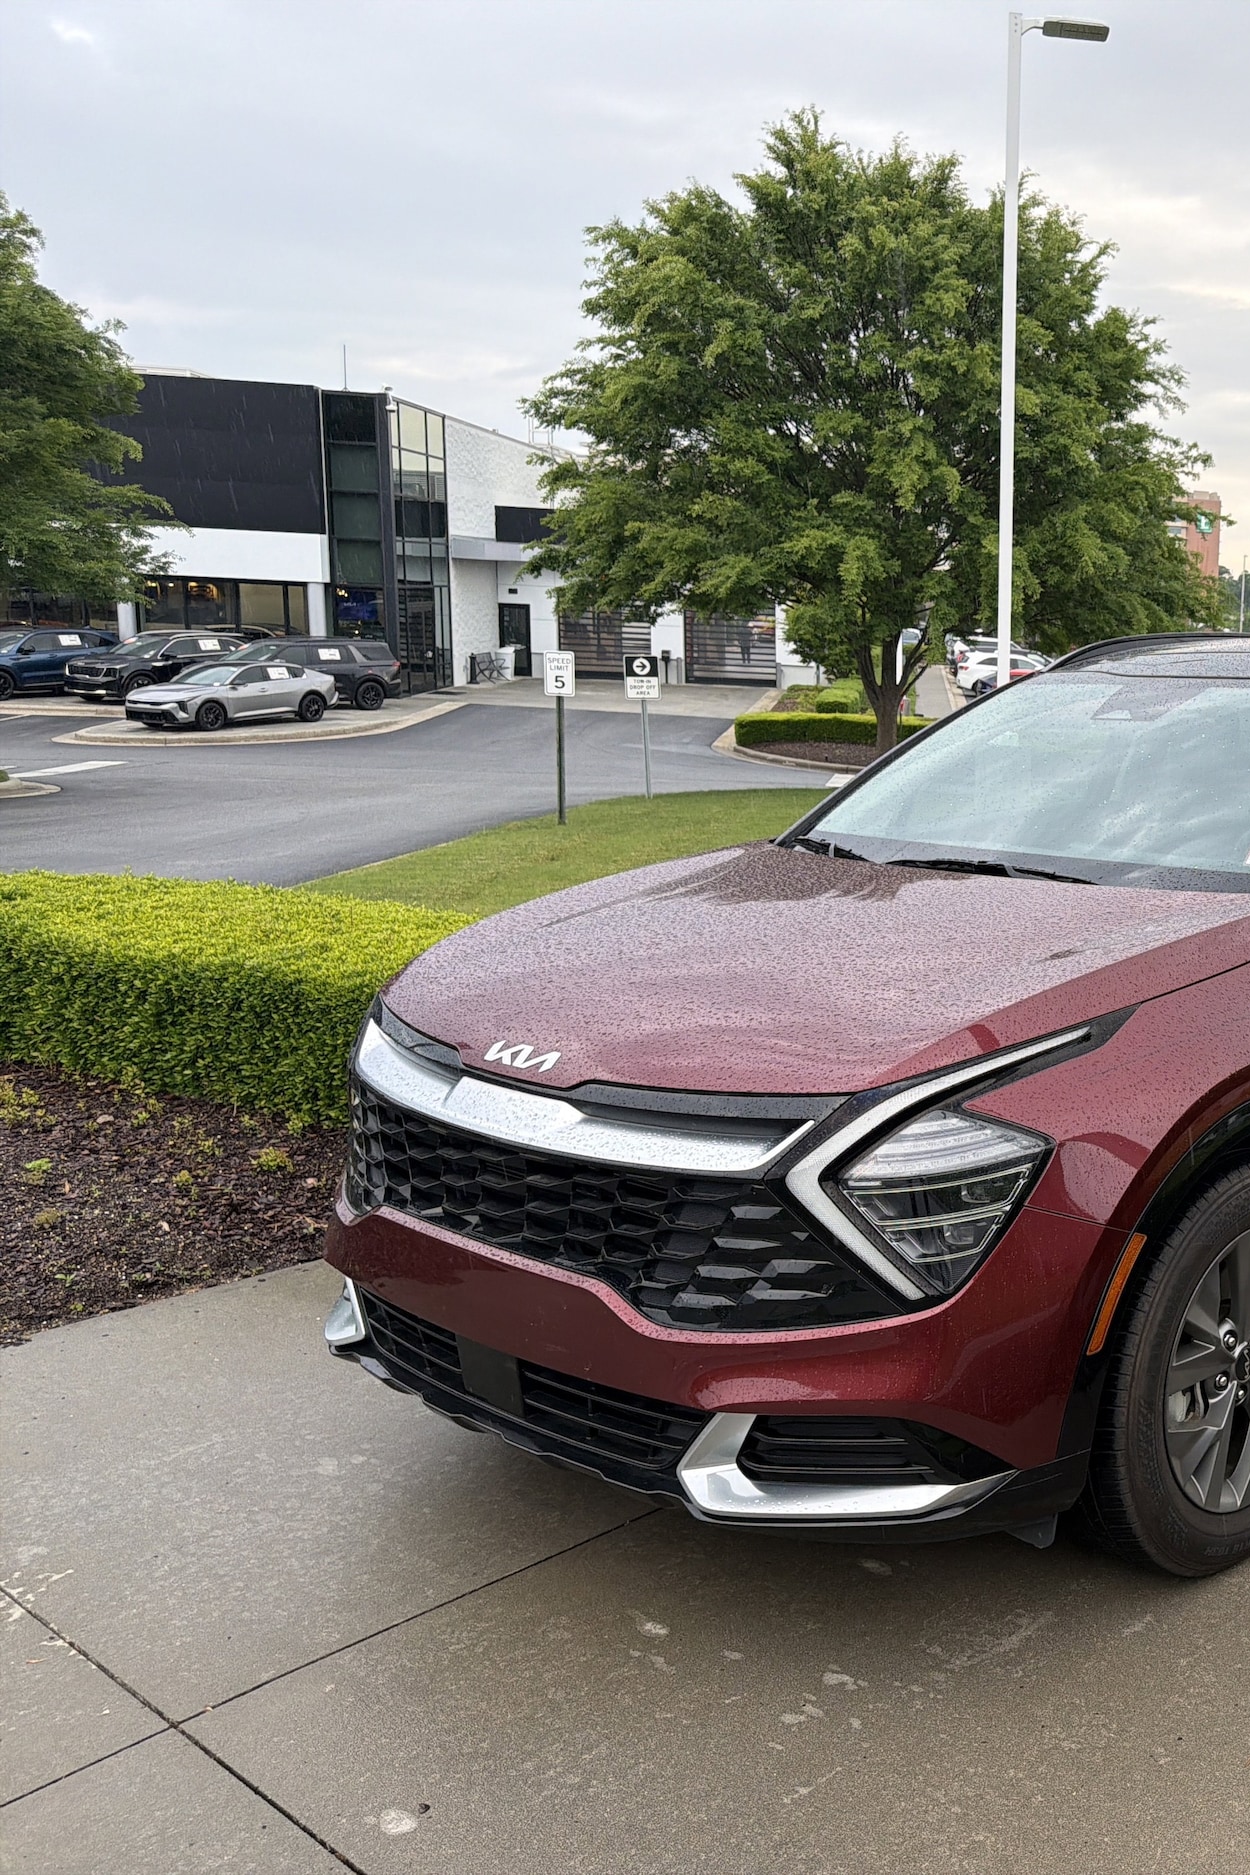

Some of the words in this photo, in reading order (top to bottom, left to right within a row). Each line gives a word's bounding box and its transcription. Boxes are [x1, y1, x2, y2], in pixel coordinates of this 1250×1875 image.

[547, 657, 572, 665] SPEED
[554, 675, 565, 689] 5
[484, 1040, 561, 1073] KIA
